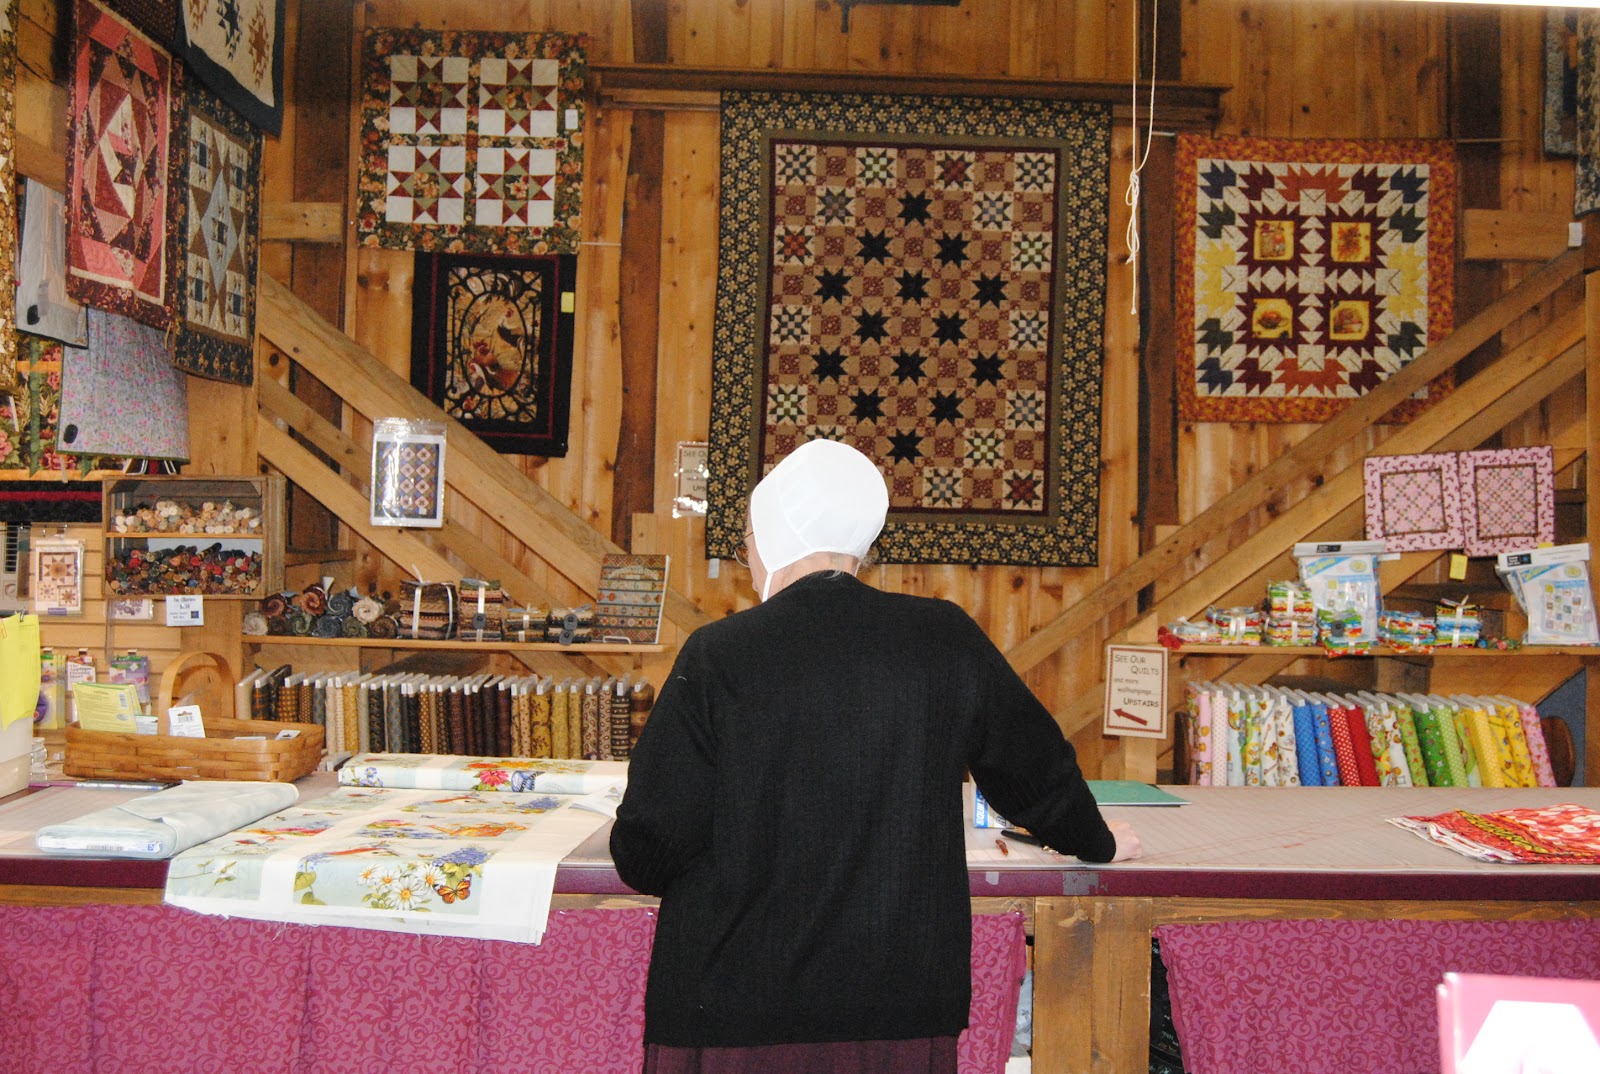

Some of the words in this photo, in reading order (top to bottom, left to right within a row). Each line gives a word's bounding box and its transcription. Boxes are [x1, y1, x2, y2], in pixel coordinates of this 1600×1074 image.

[1114, 655, 1128, 663] SEE
[1130, 655, 1146, 664] OUR
[1131, 665, 1160, 676] QUILTS
[1123, 697, 1160, 708] UPSTAIRS
